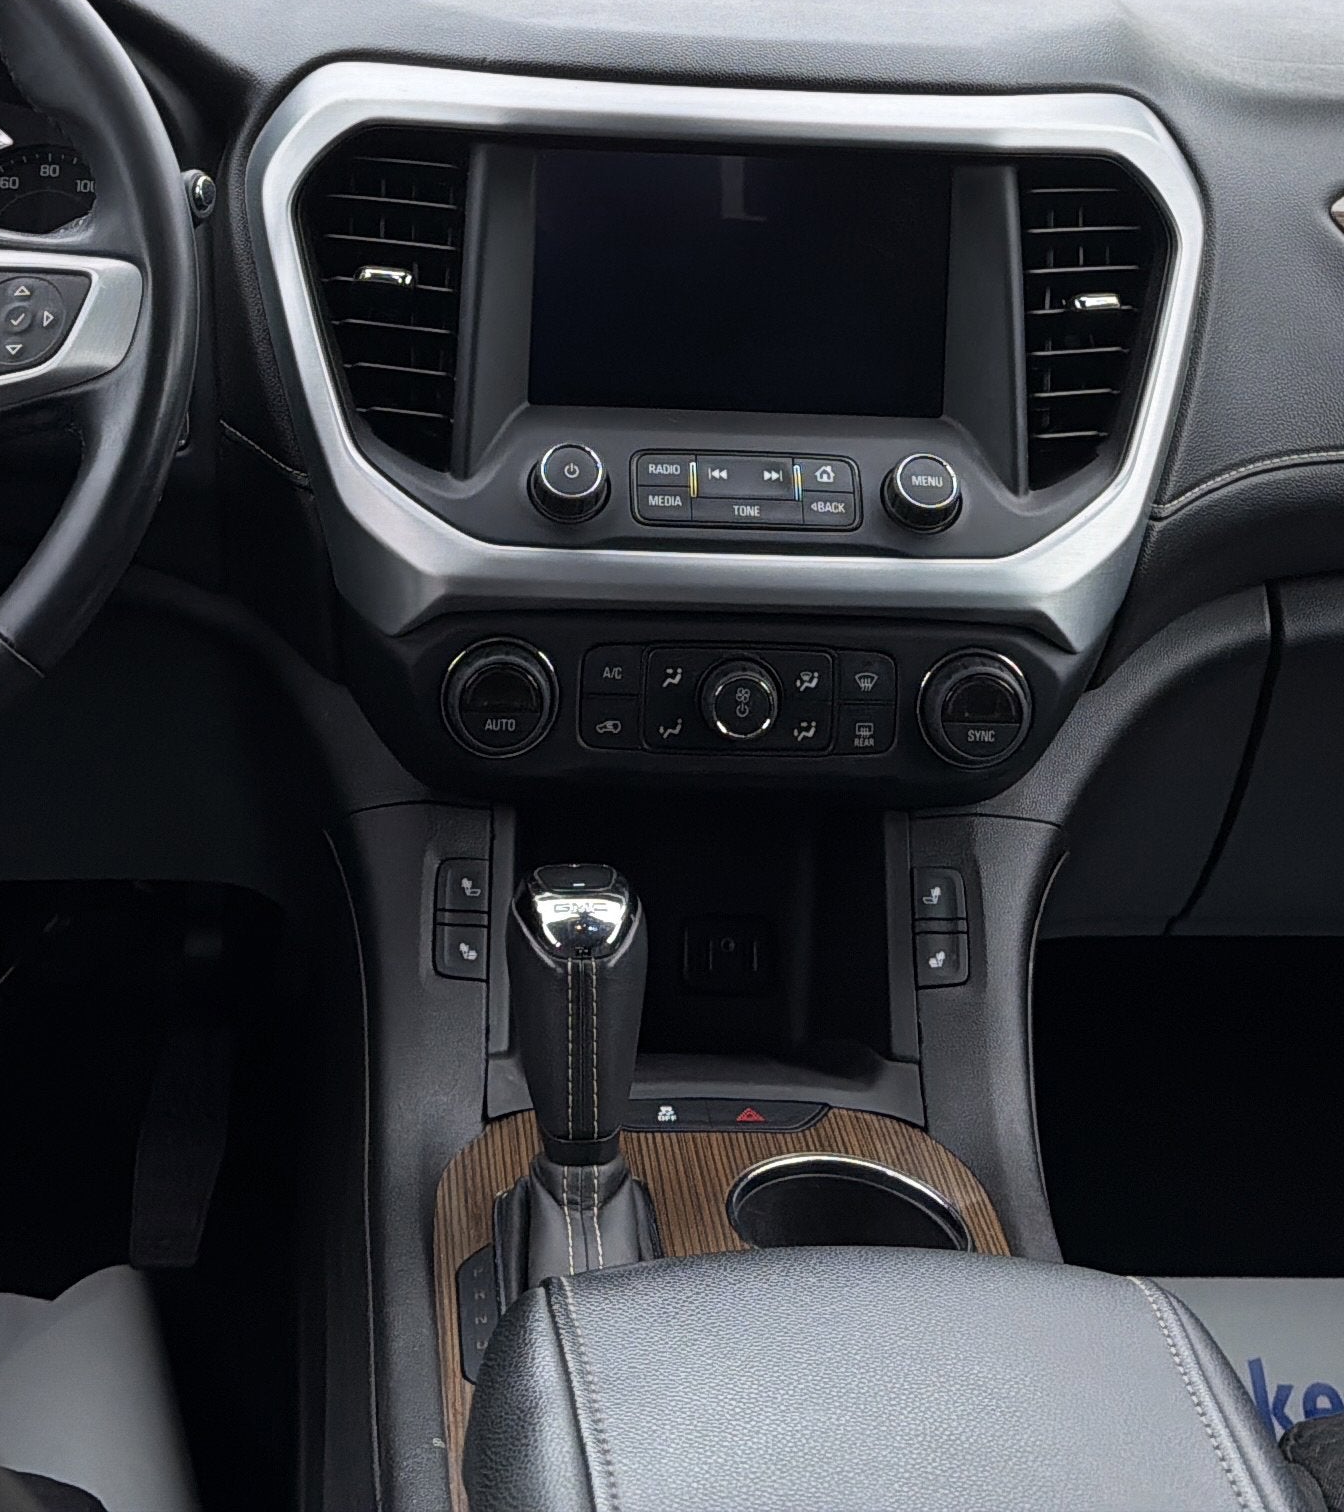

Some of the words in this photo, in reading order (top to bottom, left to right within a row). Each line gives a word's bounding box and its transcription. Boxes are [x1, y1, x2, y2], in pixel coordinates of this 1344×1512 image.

[40, 164, 59, 178] 80
[0, 176, 19, 189] 60
[648, 463, 681, 476] RADIO
[911, 476, 943, 488] MENU
[648, 495, 682, 507] MEDIA
[733, 505, 761, 518] TONE
[817, 502, 846, 514] BACK
[602, 665, 623, 681] A/C
[484, 718, 516, 732] AUTO
[854, 736, 875, 747] REAR
[967, 729, 995, 744] SYNC
[554, 902, 608, 914] GMC
[658, 1114, 676, 1122] OFF
